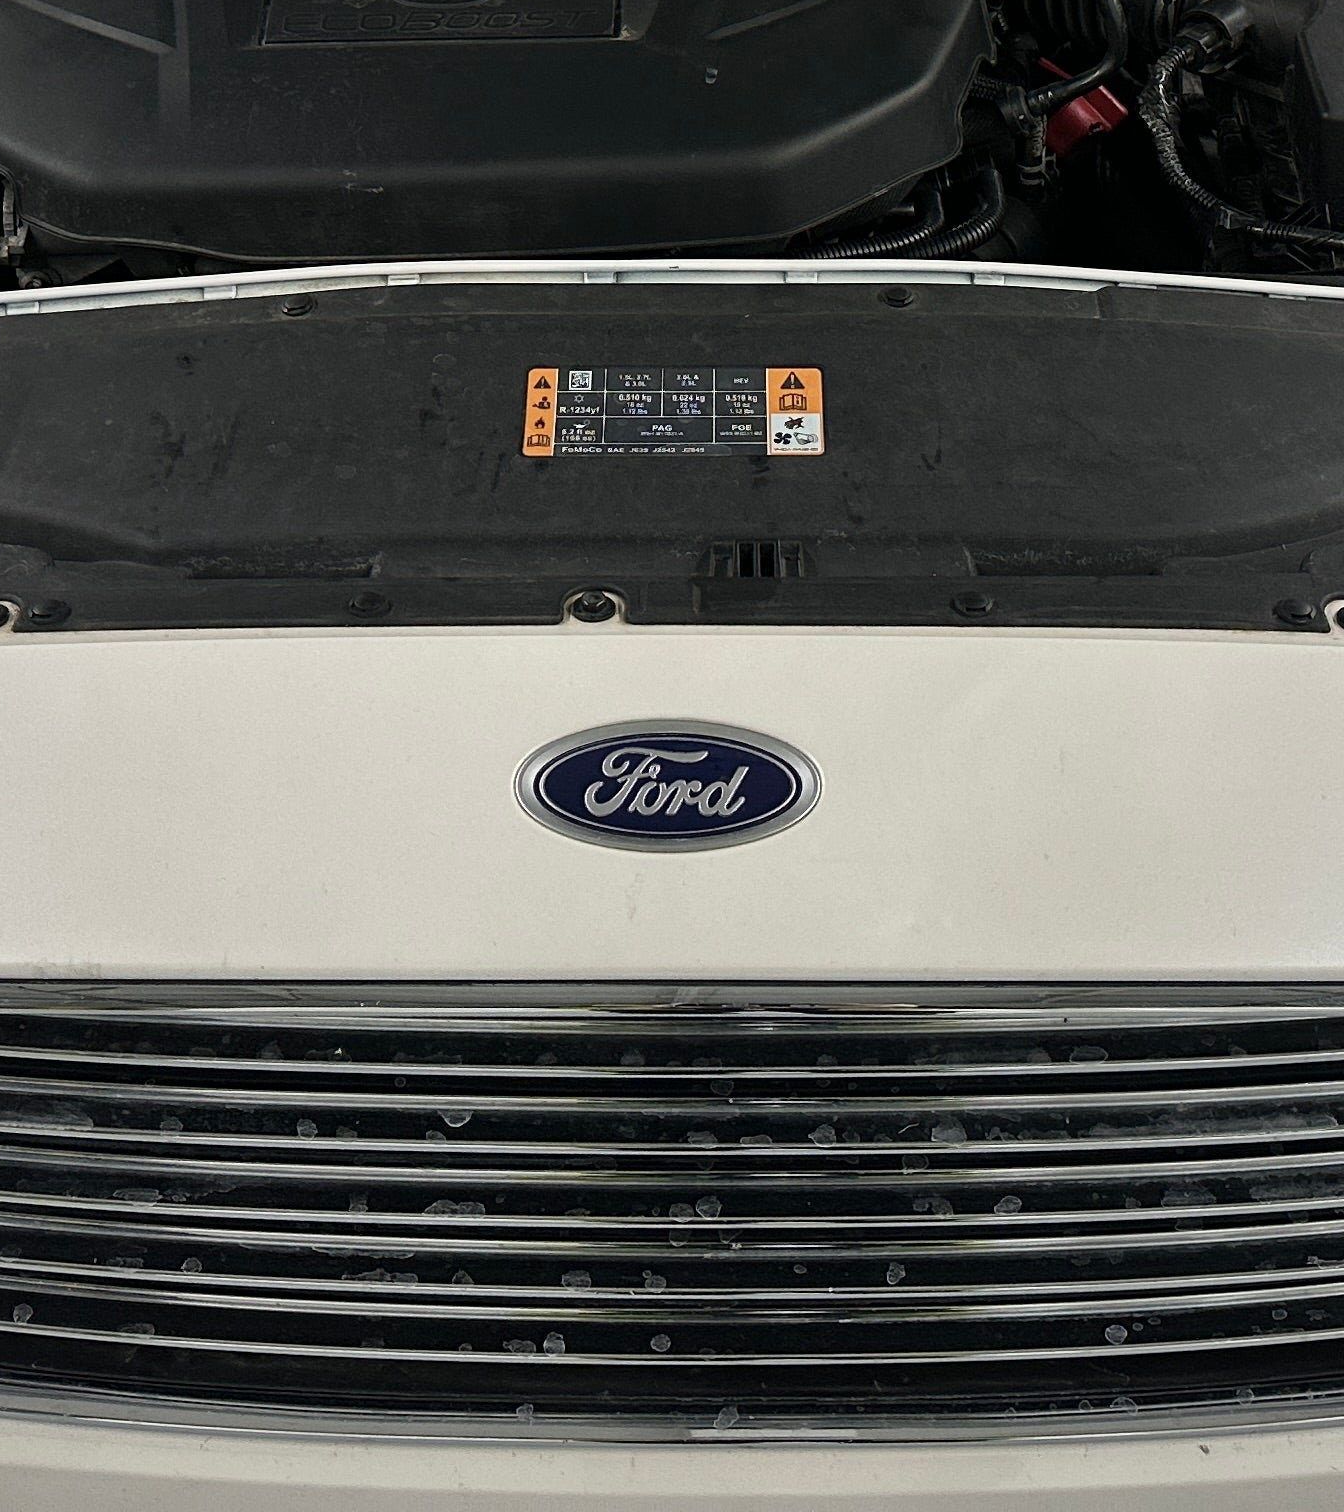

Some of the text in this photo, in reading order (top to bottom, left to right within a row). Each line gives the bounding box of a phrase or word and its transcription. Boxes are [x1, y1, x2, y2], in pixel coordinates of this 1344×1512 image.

[283, 7, 598, 34] ECOBOOST
[641, 394, 652, 403] kg
[695, 394, 706, 403] kg
[747, 394, 758, 403] kg
[559, 407, 600, 415] R-1234yf
[652, 424, 673, 432] PAG
[584, 746, 750, 817] Ford
